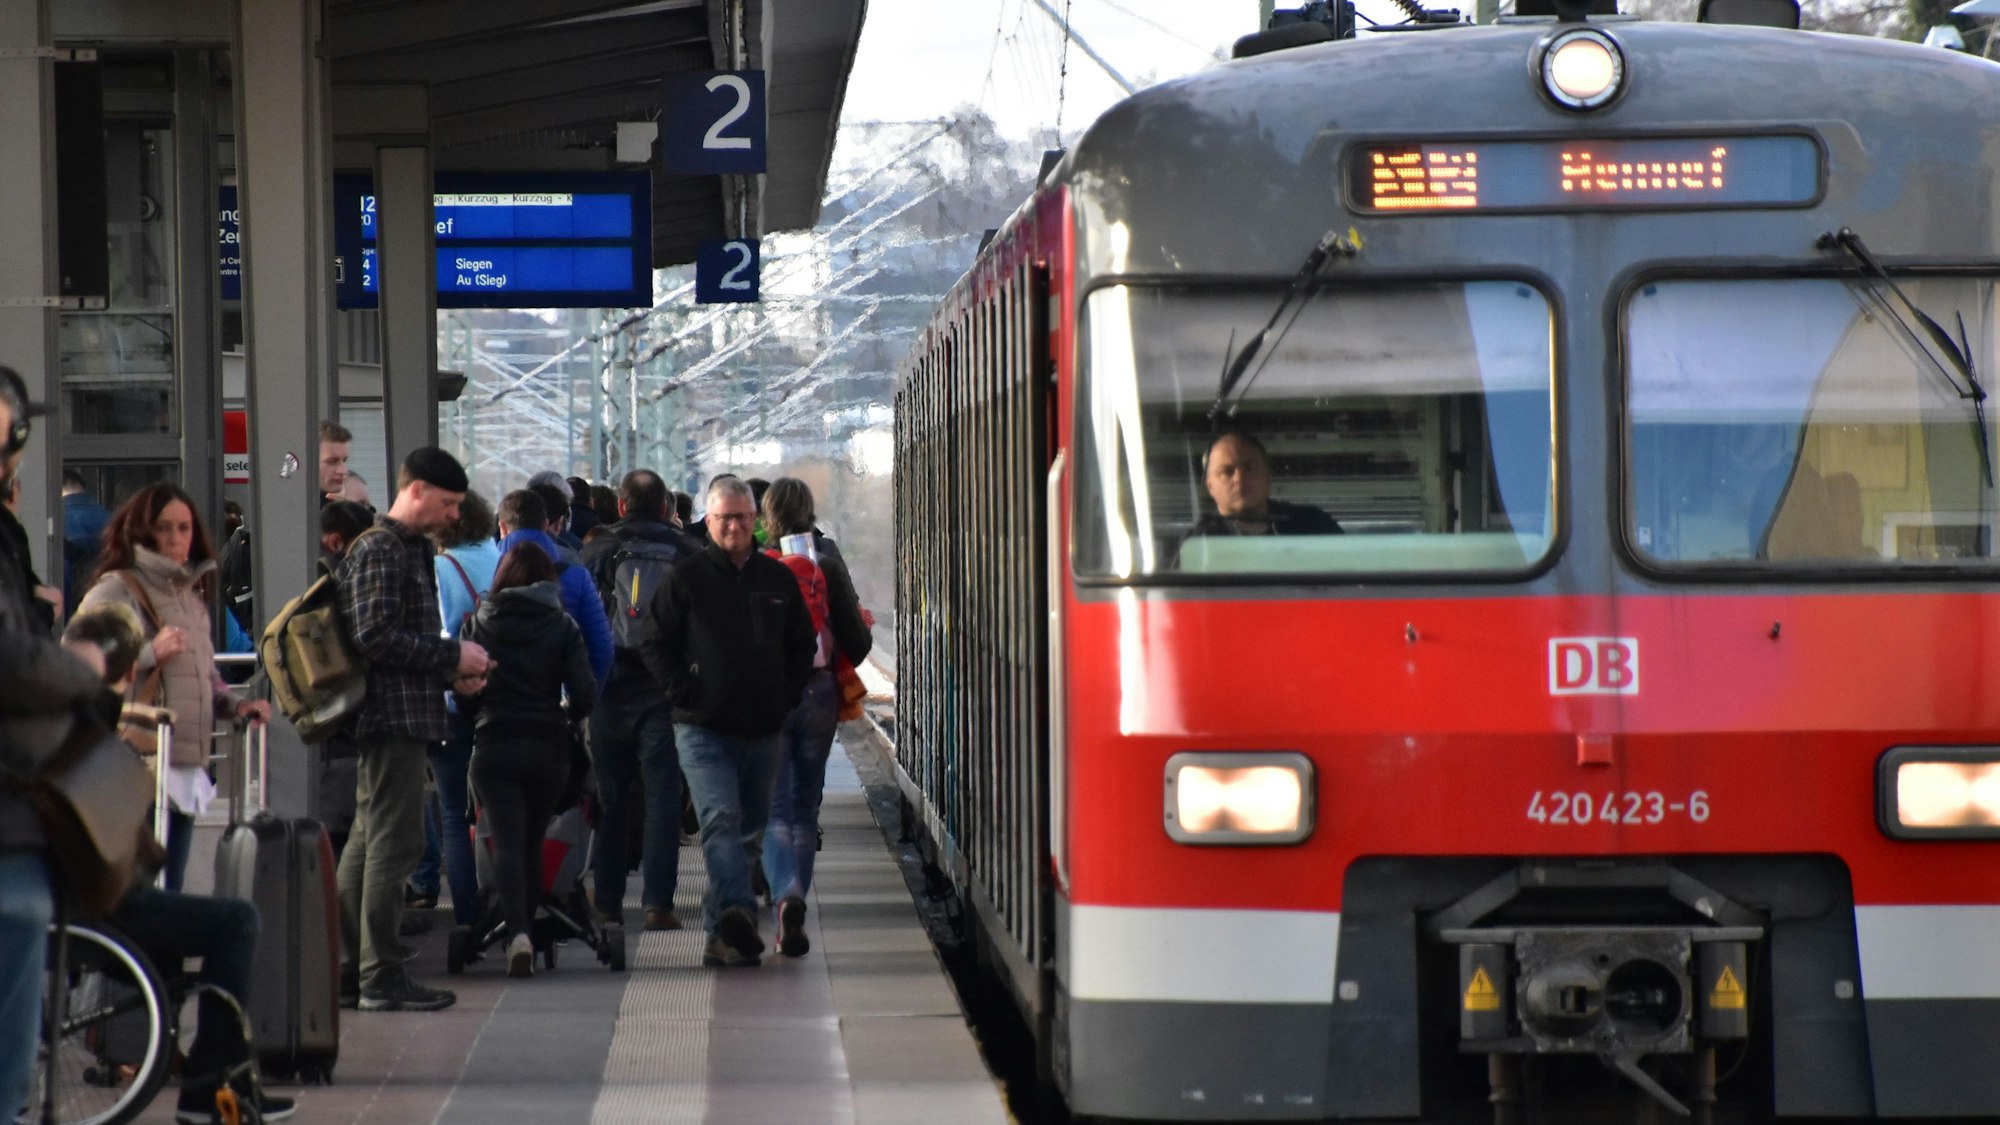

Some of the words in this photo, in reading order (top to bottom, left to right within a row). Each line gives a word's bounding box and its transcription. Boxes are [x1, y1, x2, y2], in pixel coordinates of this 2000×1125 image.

[702, 74, 752, 149] 2
[458, 194, 498, 204] Kurzzug
[513, 193, 552, 204] Kurzzug
[434, 218, 453, 234] ef
[455, 258, 493, 272] Siegen
[719, 241, 752, 290] 2
[456, 274, 472, 286] Au
[475, 274, 507, 288] (Sieg)
[1554, 641, 1635, 690] DB
[1527, 791, 1593, 825] 420
[1599, 790, 1710, 825] 423-6
